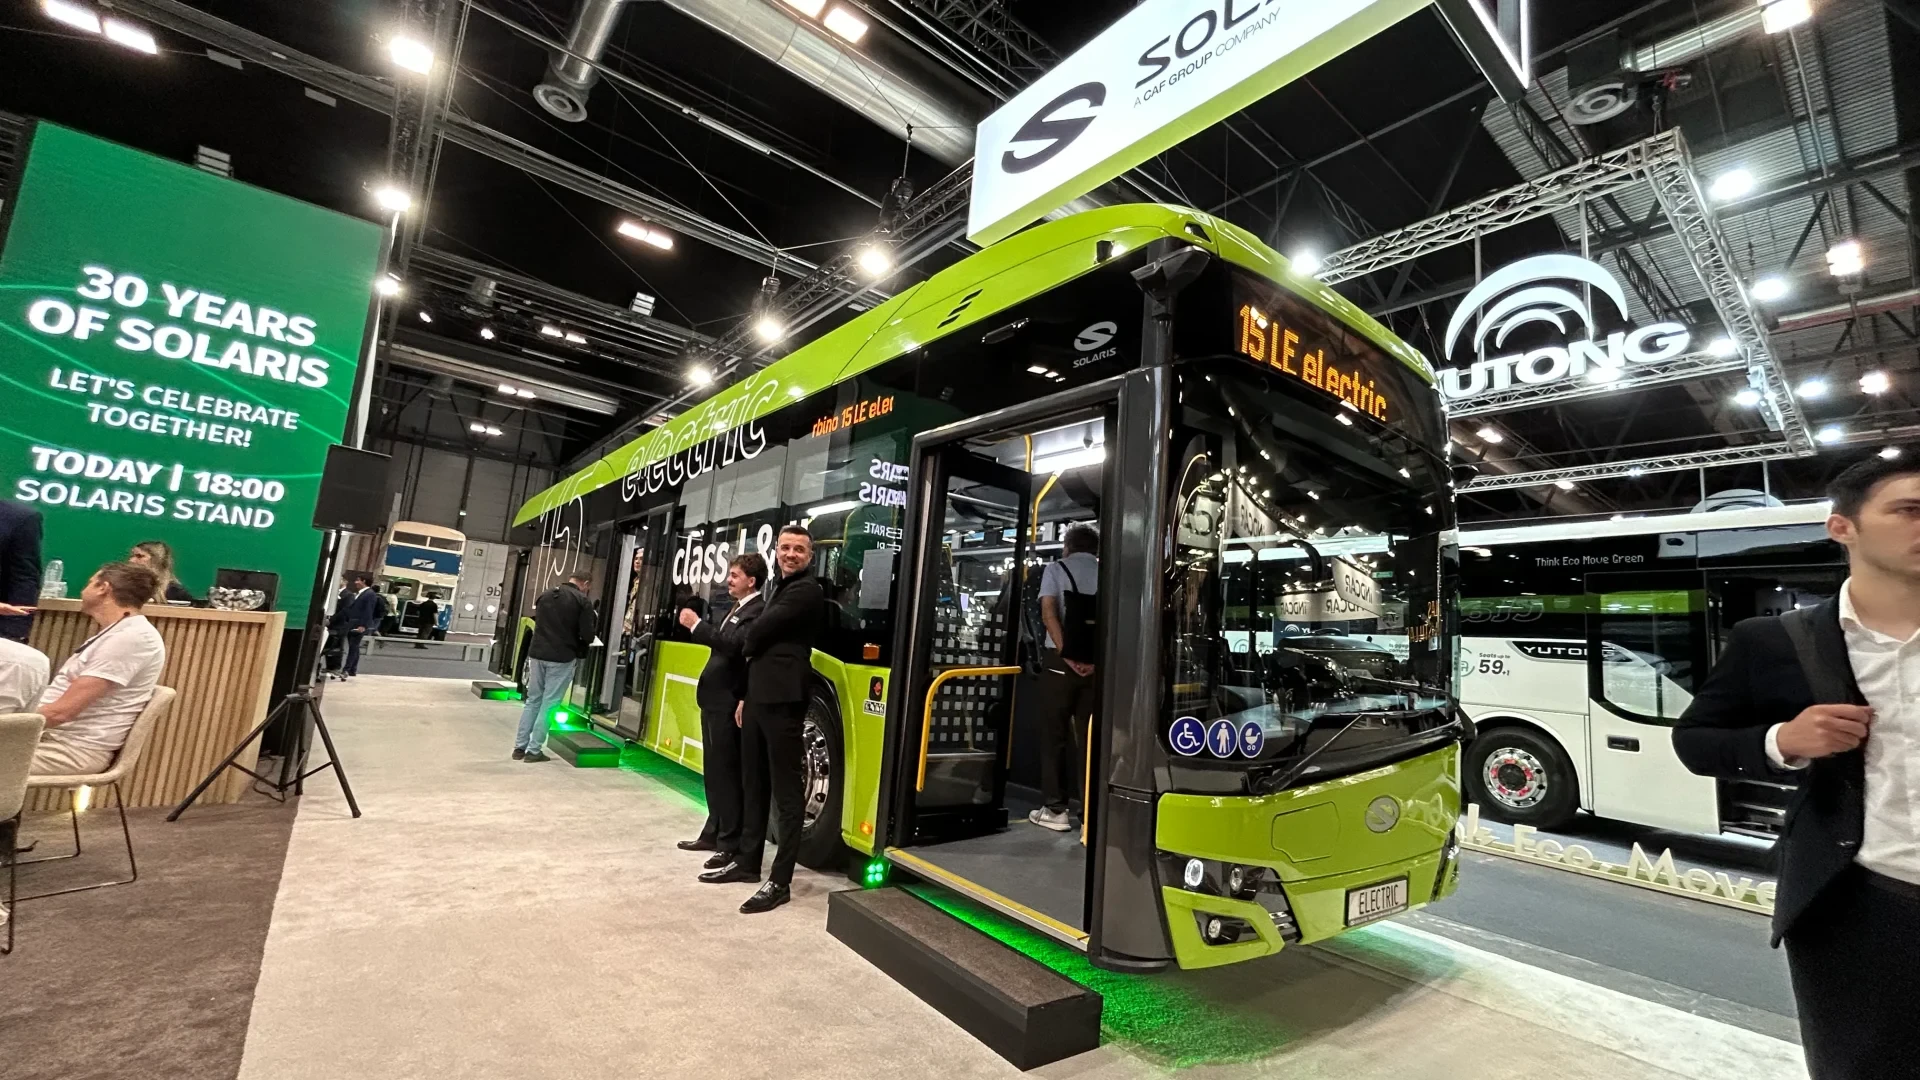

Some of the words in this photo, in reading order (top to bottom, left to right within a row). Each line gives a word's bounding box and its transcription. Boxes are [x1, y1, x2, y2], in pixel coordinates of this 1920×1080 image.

[1133, 96, 1142, 108] A
[1143, 80, 1166, 101] CAF
[1168, 52, 1213, 86] GROUP
[1215, 7, 1281, 57] COMPANY
[1135, 0, 1274, 89] SOL
[76, 266, 149, 308] 30
[161, 284, 318, 347] YEARS
[28, 299, 111, 340] OF
[115, 317, 331, 388] SOLARIS
[1073, 347, 1116, 368] SOLARIS
[1240, 305, 1268, 361] 15
[1270, 322, 1299, 376] LE
[1302, 349, 1387, 421] electric
[50, 368, 136, 400] LET'S
[142, 385, 301, 430] CELEBRATE
[87, 402, 253, 447] TOGETHER!
[841, 405, 854, 428] 15
[853, 401, 869, 424] LE
[622, 371, 779, 503] electric
[32, 446, 164, 485] TODAY
[193, 471, 285, 502] 18:00
[15, 479, 166, 516] SOLARIS
[173, 499, 276, 529] STAND
[672, 530, 730, 585] class
[1535, 557, 1560, 567] Think
[1562, 556, 1580, 566] Eco
[1583, 555, 1610, 565] Move
[1612, 554, 1645, 564] Green
[1359, 884, 1399, 915] ELECTRIC
